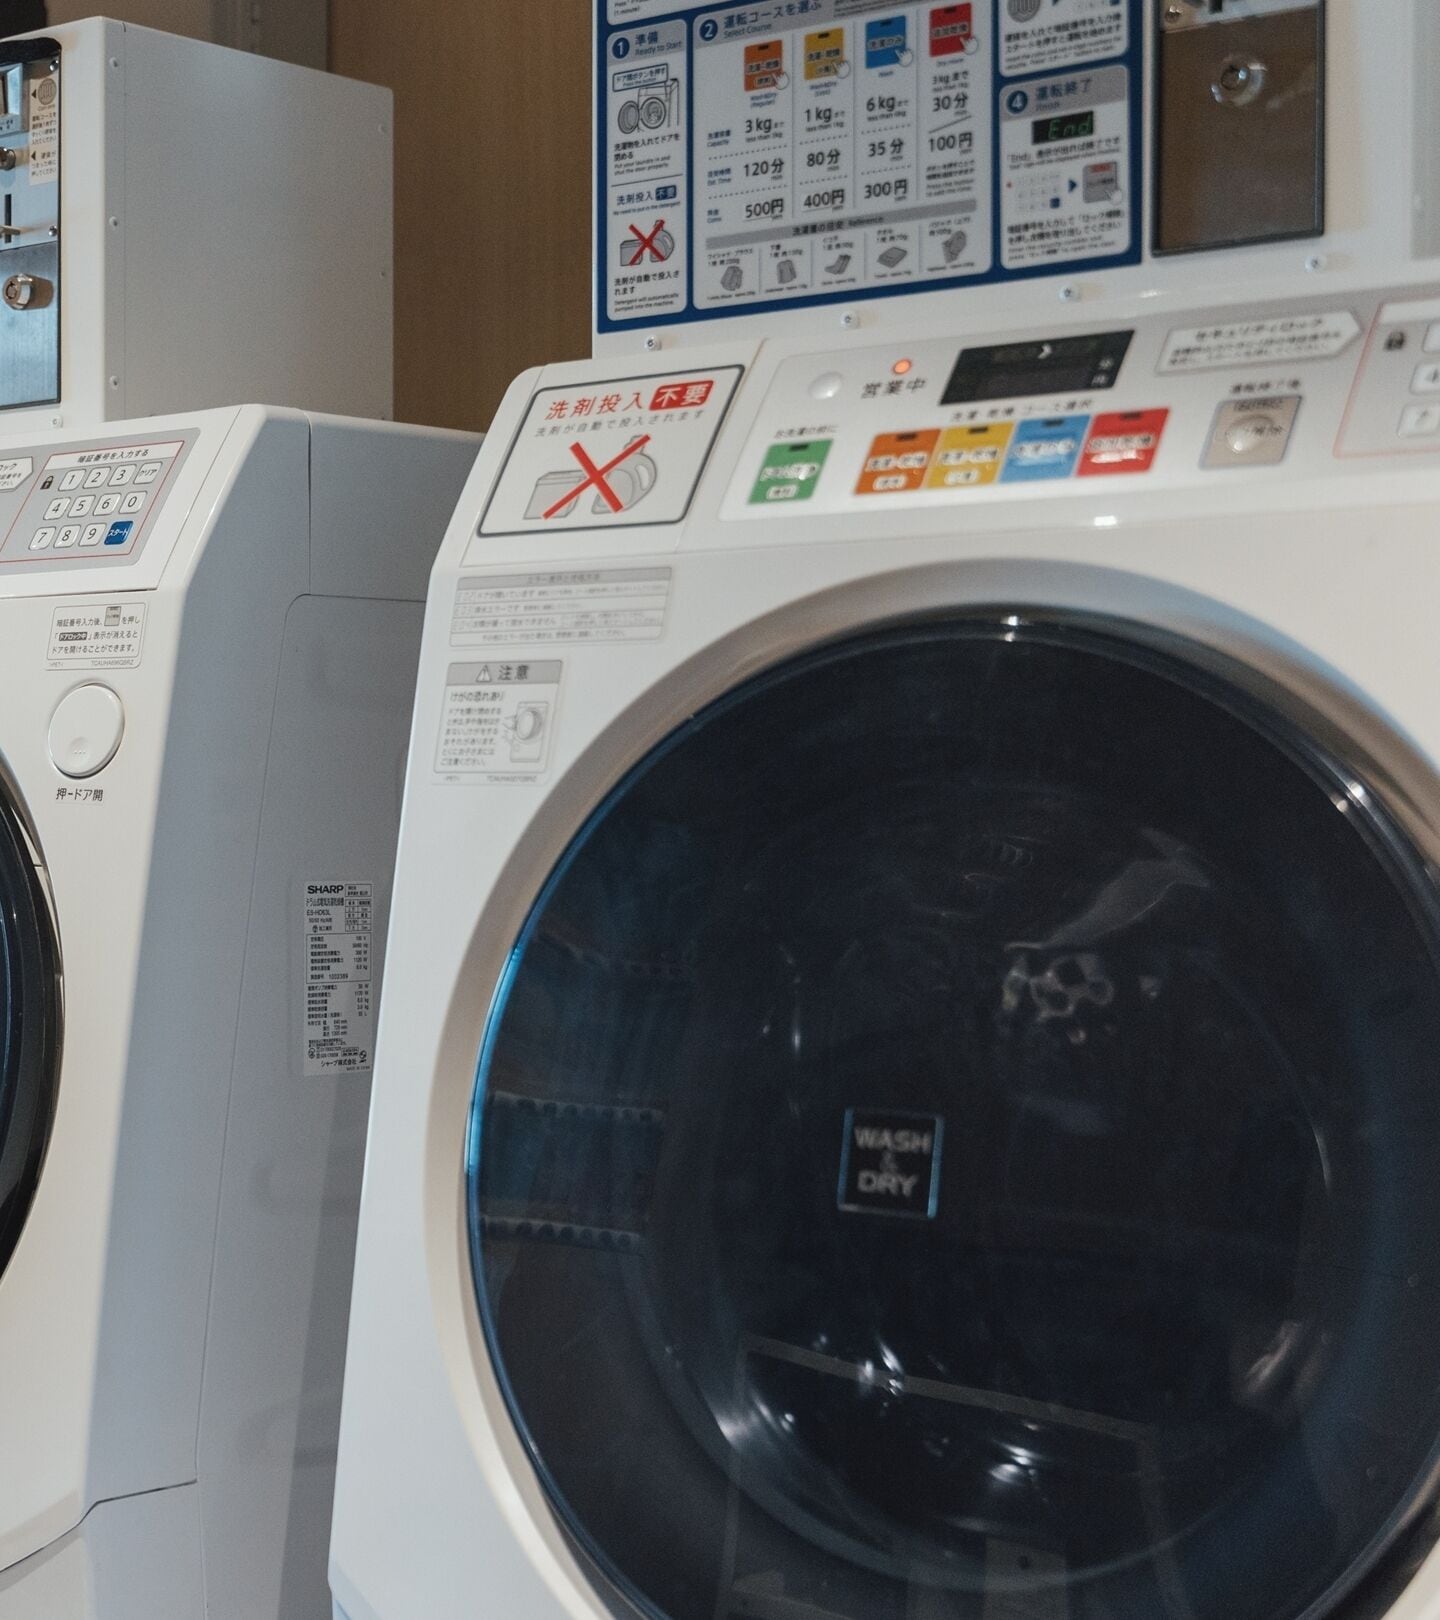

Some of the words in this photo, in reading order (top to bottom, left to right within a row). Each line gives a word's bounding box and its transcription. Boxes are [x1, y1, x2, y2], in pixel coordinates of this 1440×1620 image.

[724, 0, 821, 28] 運転コースを選ぶ
[635, 31, 658, 46] 準備
[724, 27, 746, 38] Select
[746, 23, 772, 34] Course
[635, 47, 656, 56] Ready
[1036, 78, 1091, 100] 運転終了
[1049, 114, 1092, 140] End
[614, 133, 679, 151] 洗濯物を入れてドアを
[928, 131, 973, 152] 100円
[614, 152, 633, 162] 閉める
[743, 158, 784, 177] 120分
[806, 148, 840, 168] 80分
[868, 138, 904, 157] 35分
[616, 191, 653, 206] 洗剤投入
[745, 198, 784, 219] 500円
[803, 189, 845, 208] 400円
[864, 179, 908, 199] 300円
[614, 270, 679, 286] 洗剤が自動で投入さ
[614, 287, 635, 295] れます
[1195, 318, 1323, 342] セキュリティロック
[862, 377, 926, 399] 営業中
[544, 391, 644, 421] 洗剤投入
[655, 383, 711, 407] 不要
[535, 409, 705, 438] 洗剤が自動で投入されます
[77, 450, 149, 464] 暗証番号を入力する
[91, 472, 101, 483] 2
[116, 469, 126, 480] 3
[51, 503, 61, 514] 4
[76, 500, 86, 511] 5
[102, 498, 111, 509] 6
[127, 496, 138, 507] 0
[38, 532, 47, 543] 7
[61, 530, 71, 541] 8
[87, 528, 97, 539] 9
[109, 528, 130, 538] スタート
[122, 616, 140, 625] を押し
[52, 644, 134, 654] ドアを開けることができます。
[497, 665, 530, 681] 注意
[450, 691, 505, 702] けがの恐れあり
[440, 757, 487, 767] ご注意ください。
[307, 884, 344, 895] SHARP
[321, 1058, 357, 1068] シャープ株式会社
[854, 1126, 932, 1154] WASH
[857, 1169, 919, 1197] DRY
